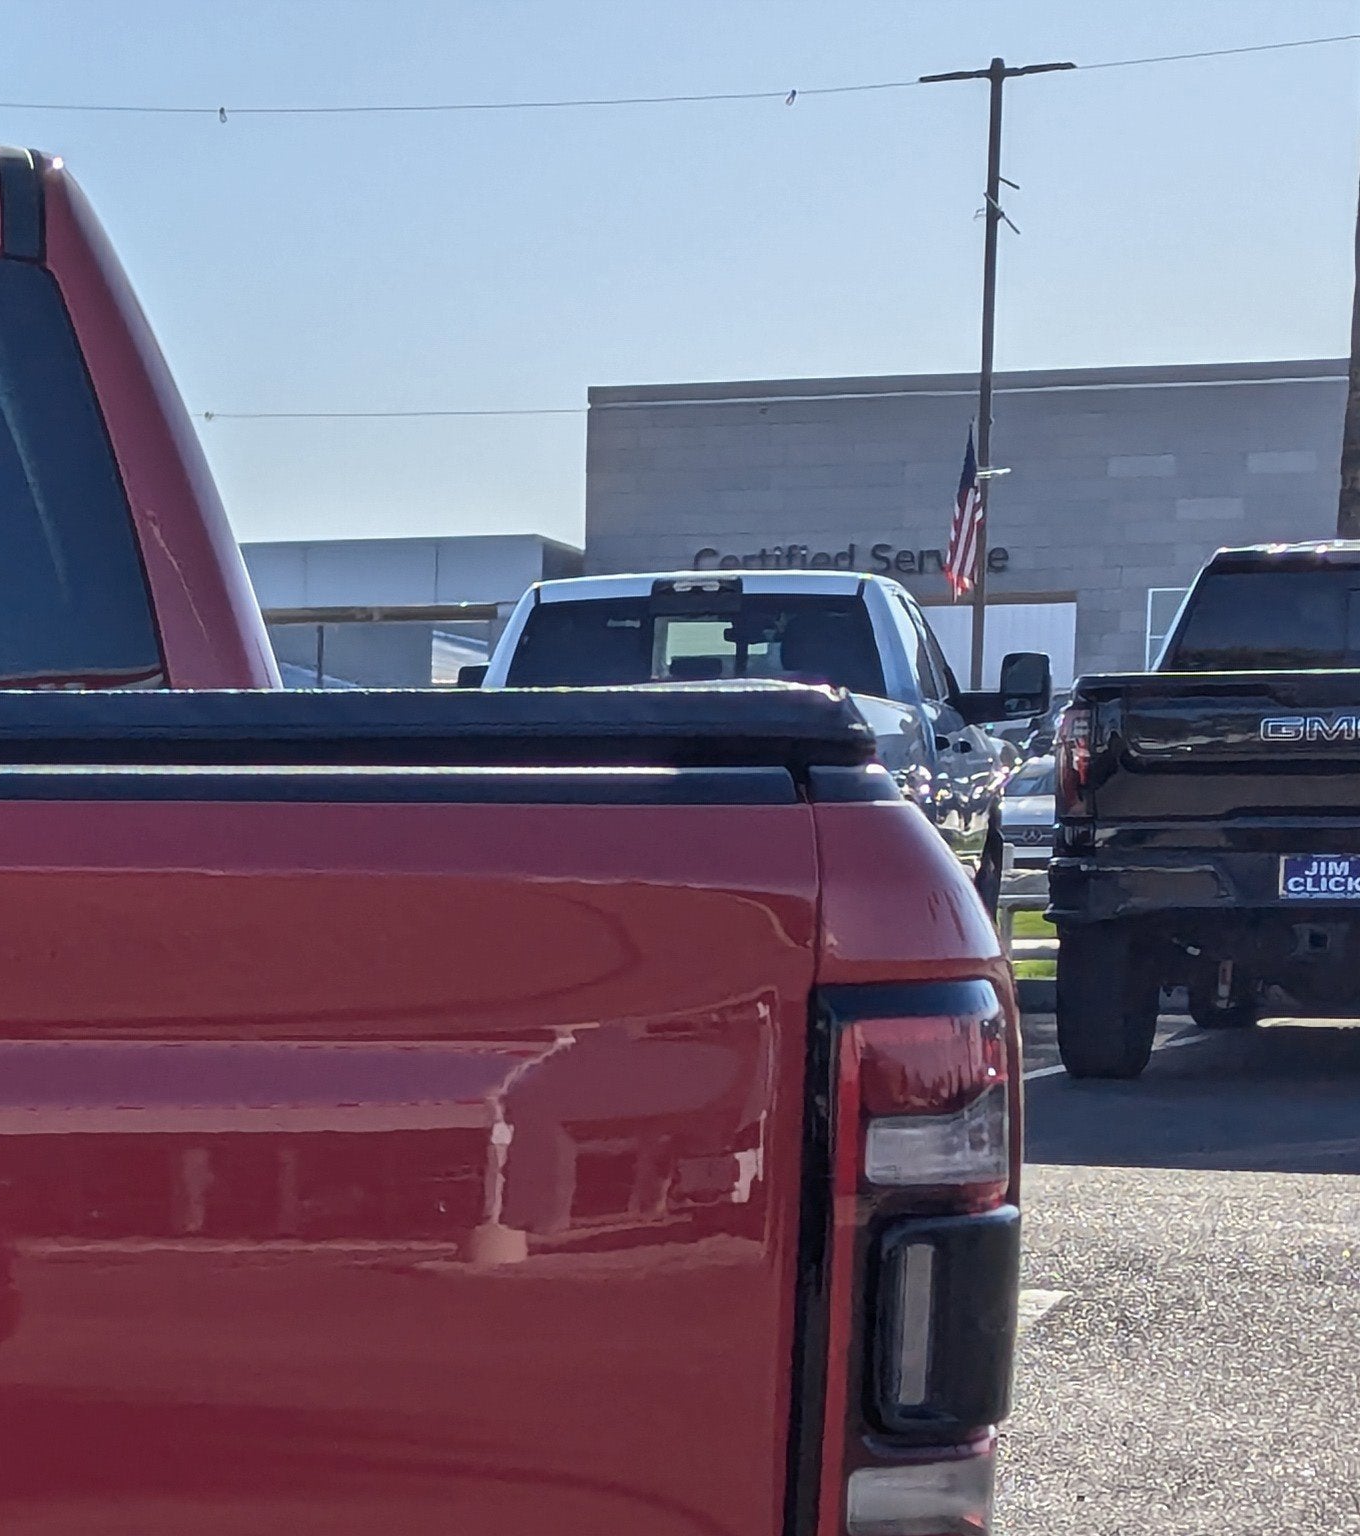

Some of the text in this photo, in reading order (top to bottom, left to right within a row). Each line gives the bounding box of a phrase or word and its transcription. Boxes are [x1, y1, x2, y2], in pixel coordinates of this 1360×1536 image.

[693, 543, 1010, 574] Certified Sere
[1260, 716, 1360, 742] GM
[1304, 861, 1350, 876] JIM
